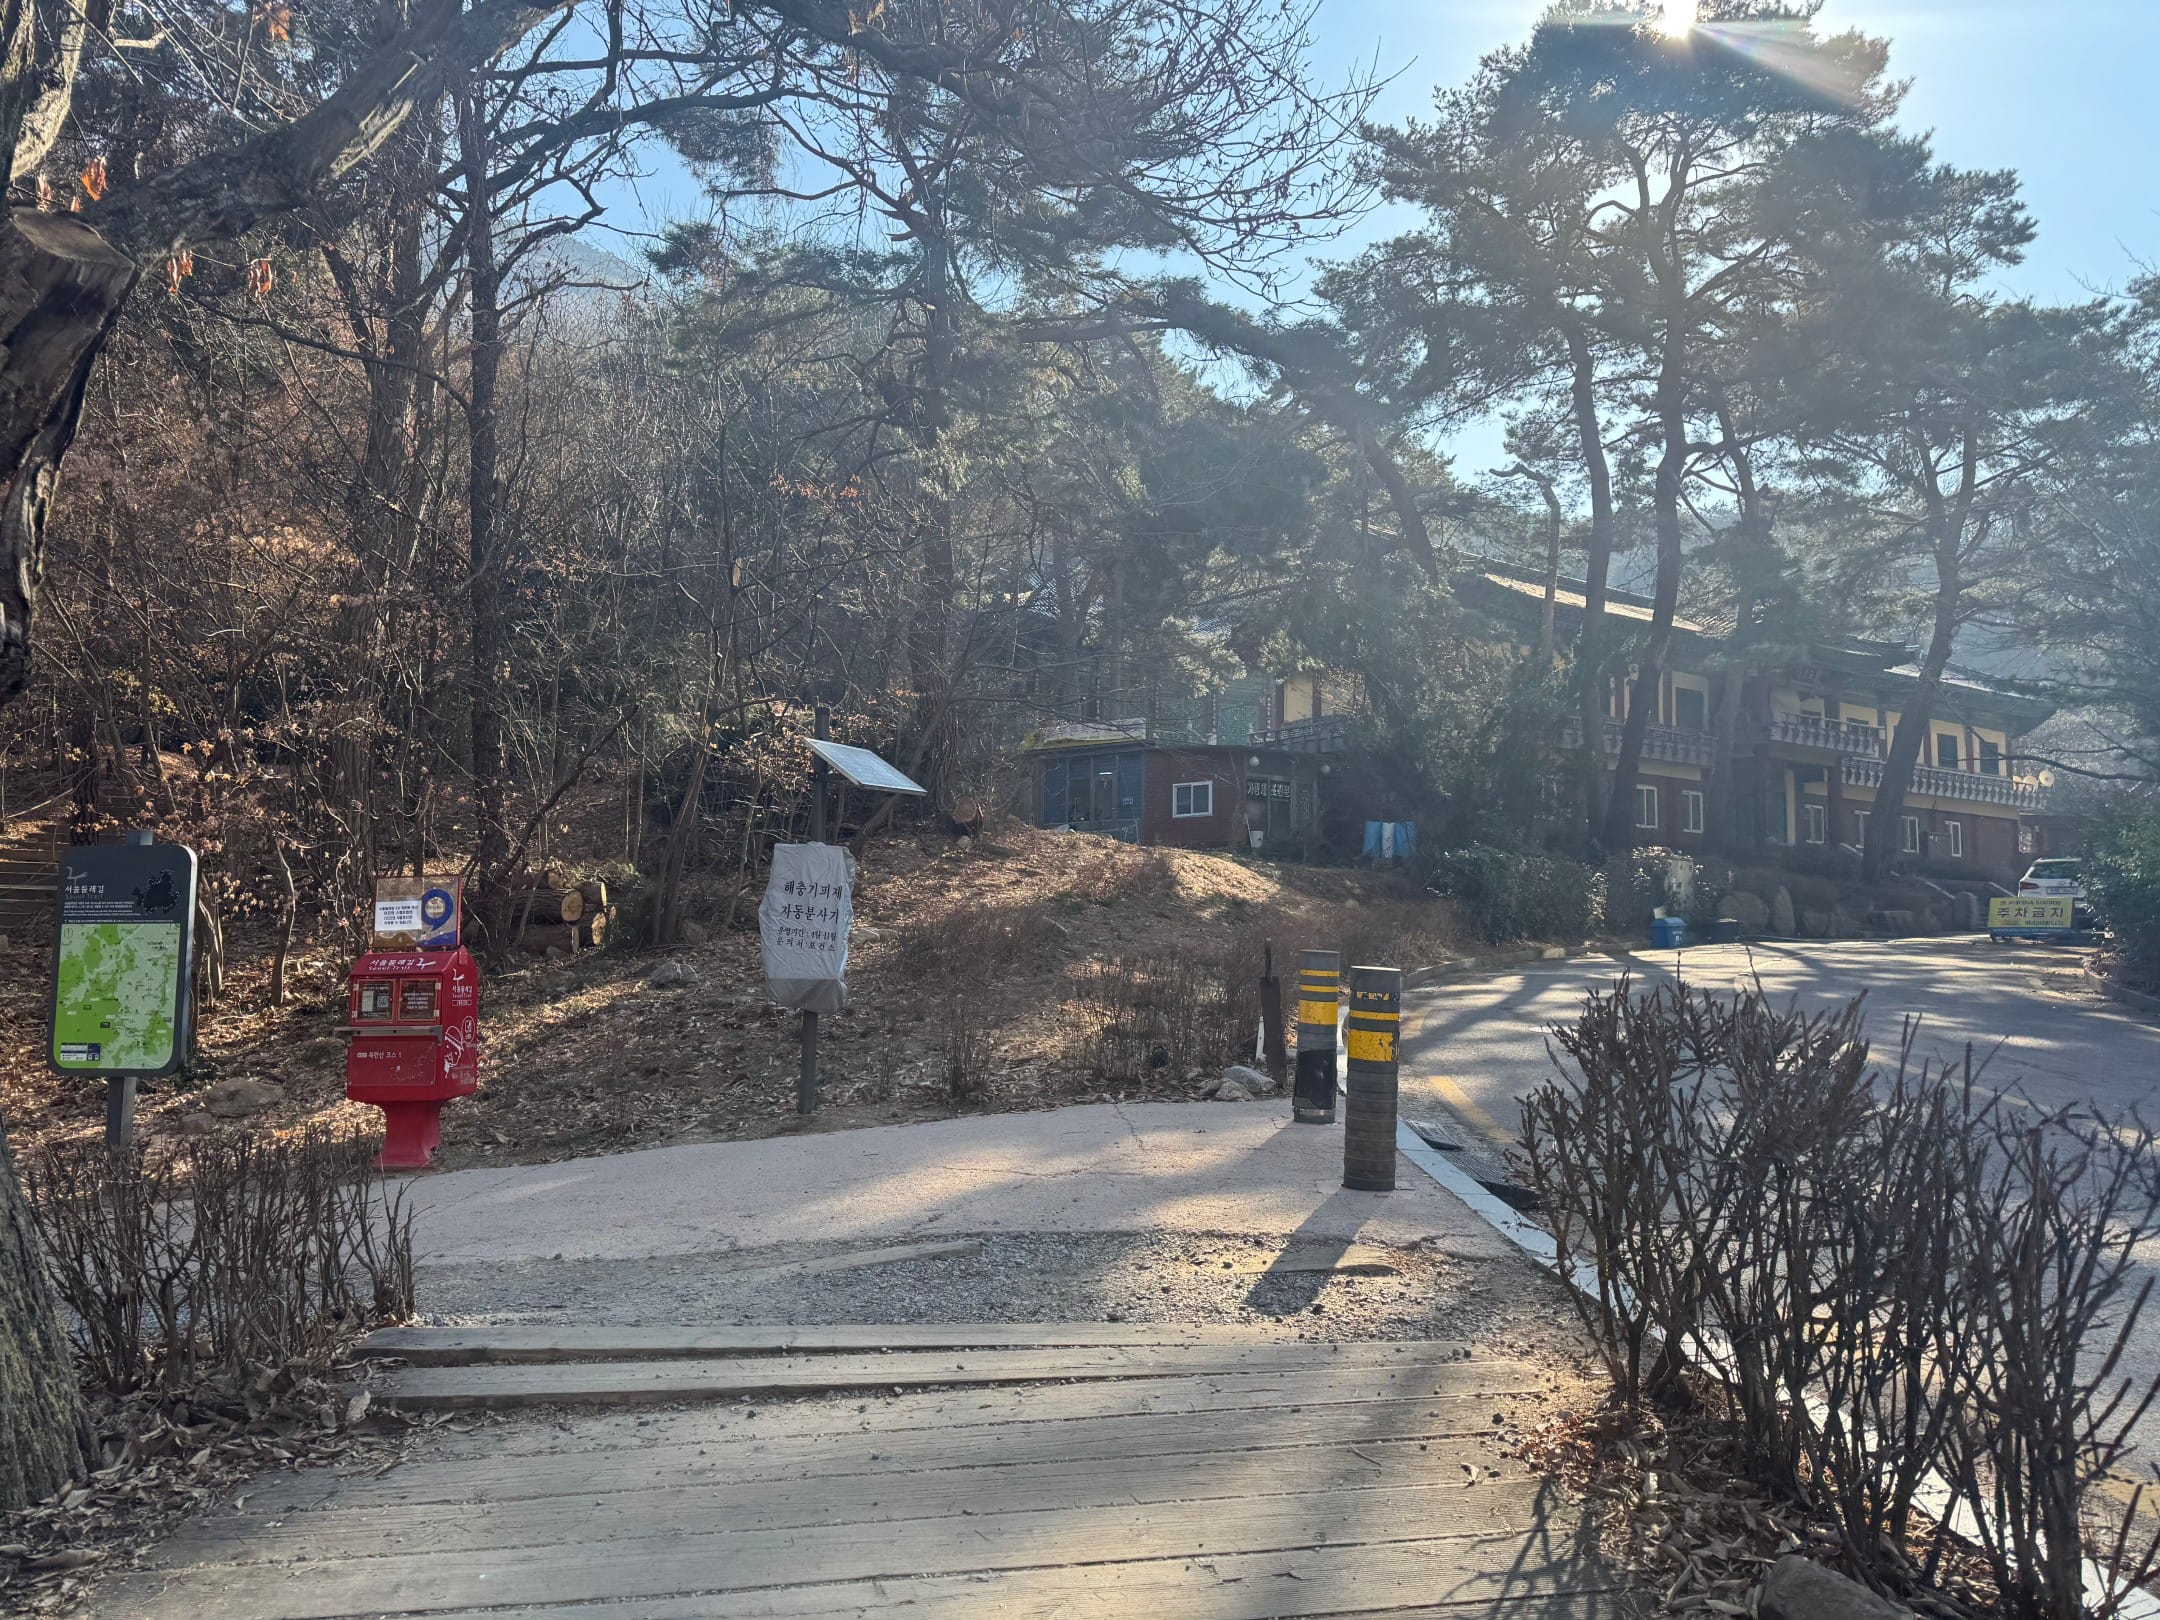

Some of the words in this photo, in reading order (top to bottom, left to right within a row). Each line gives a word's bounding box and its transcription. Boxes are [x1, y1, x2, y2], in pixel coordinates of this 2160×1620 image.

[65, 884, 105, 894] 서울둘레길
[784, 880, 843, 901] 해충기피제
[780, 903, 839, 924] 자동분사기
[1996, 906, 2064, 919] 주차금지
